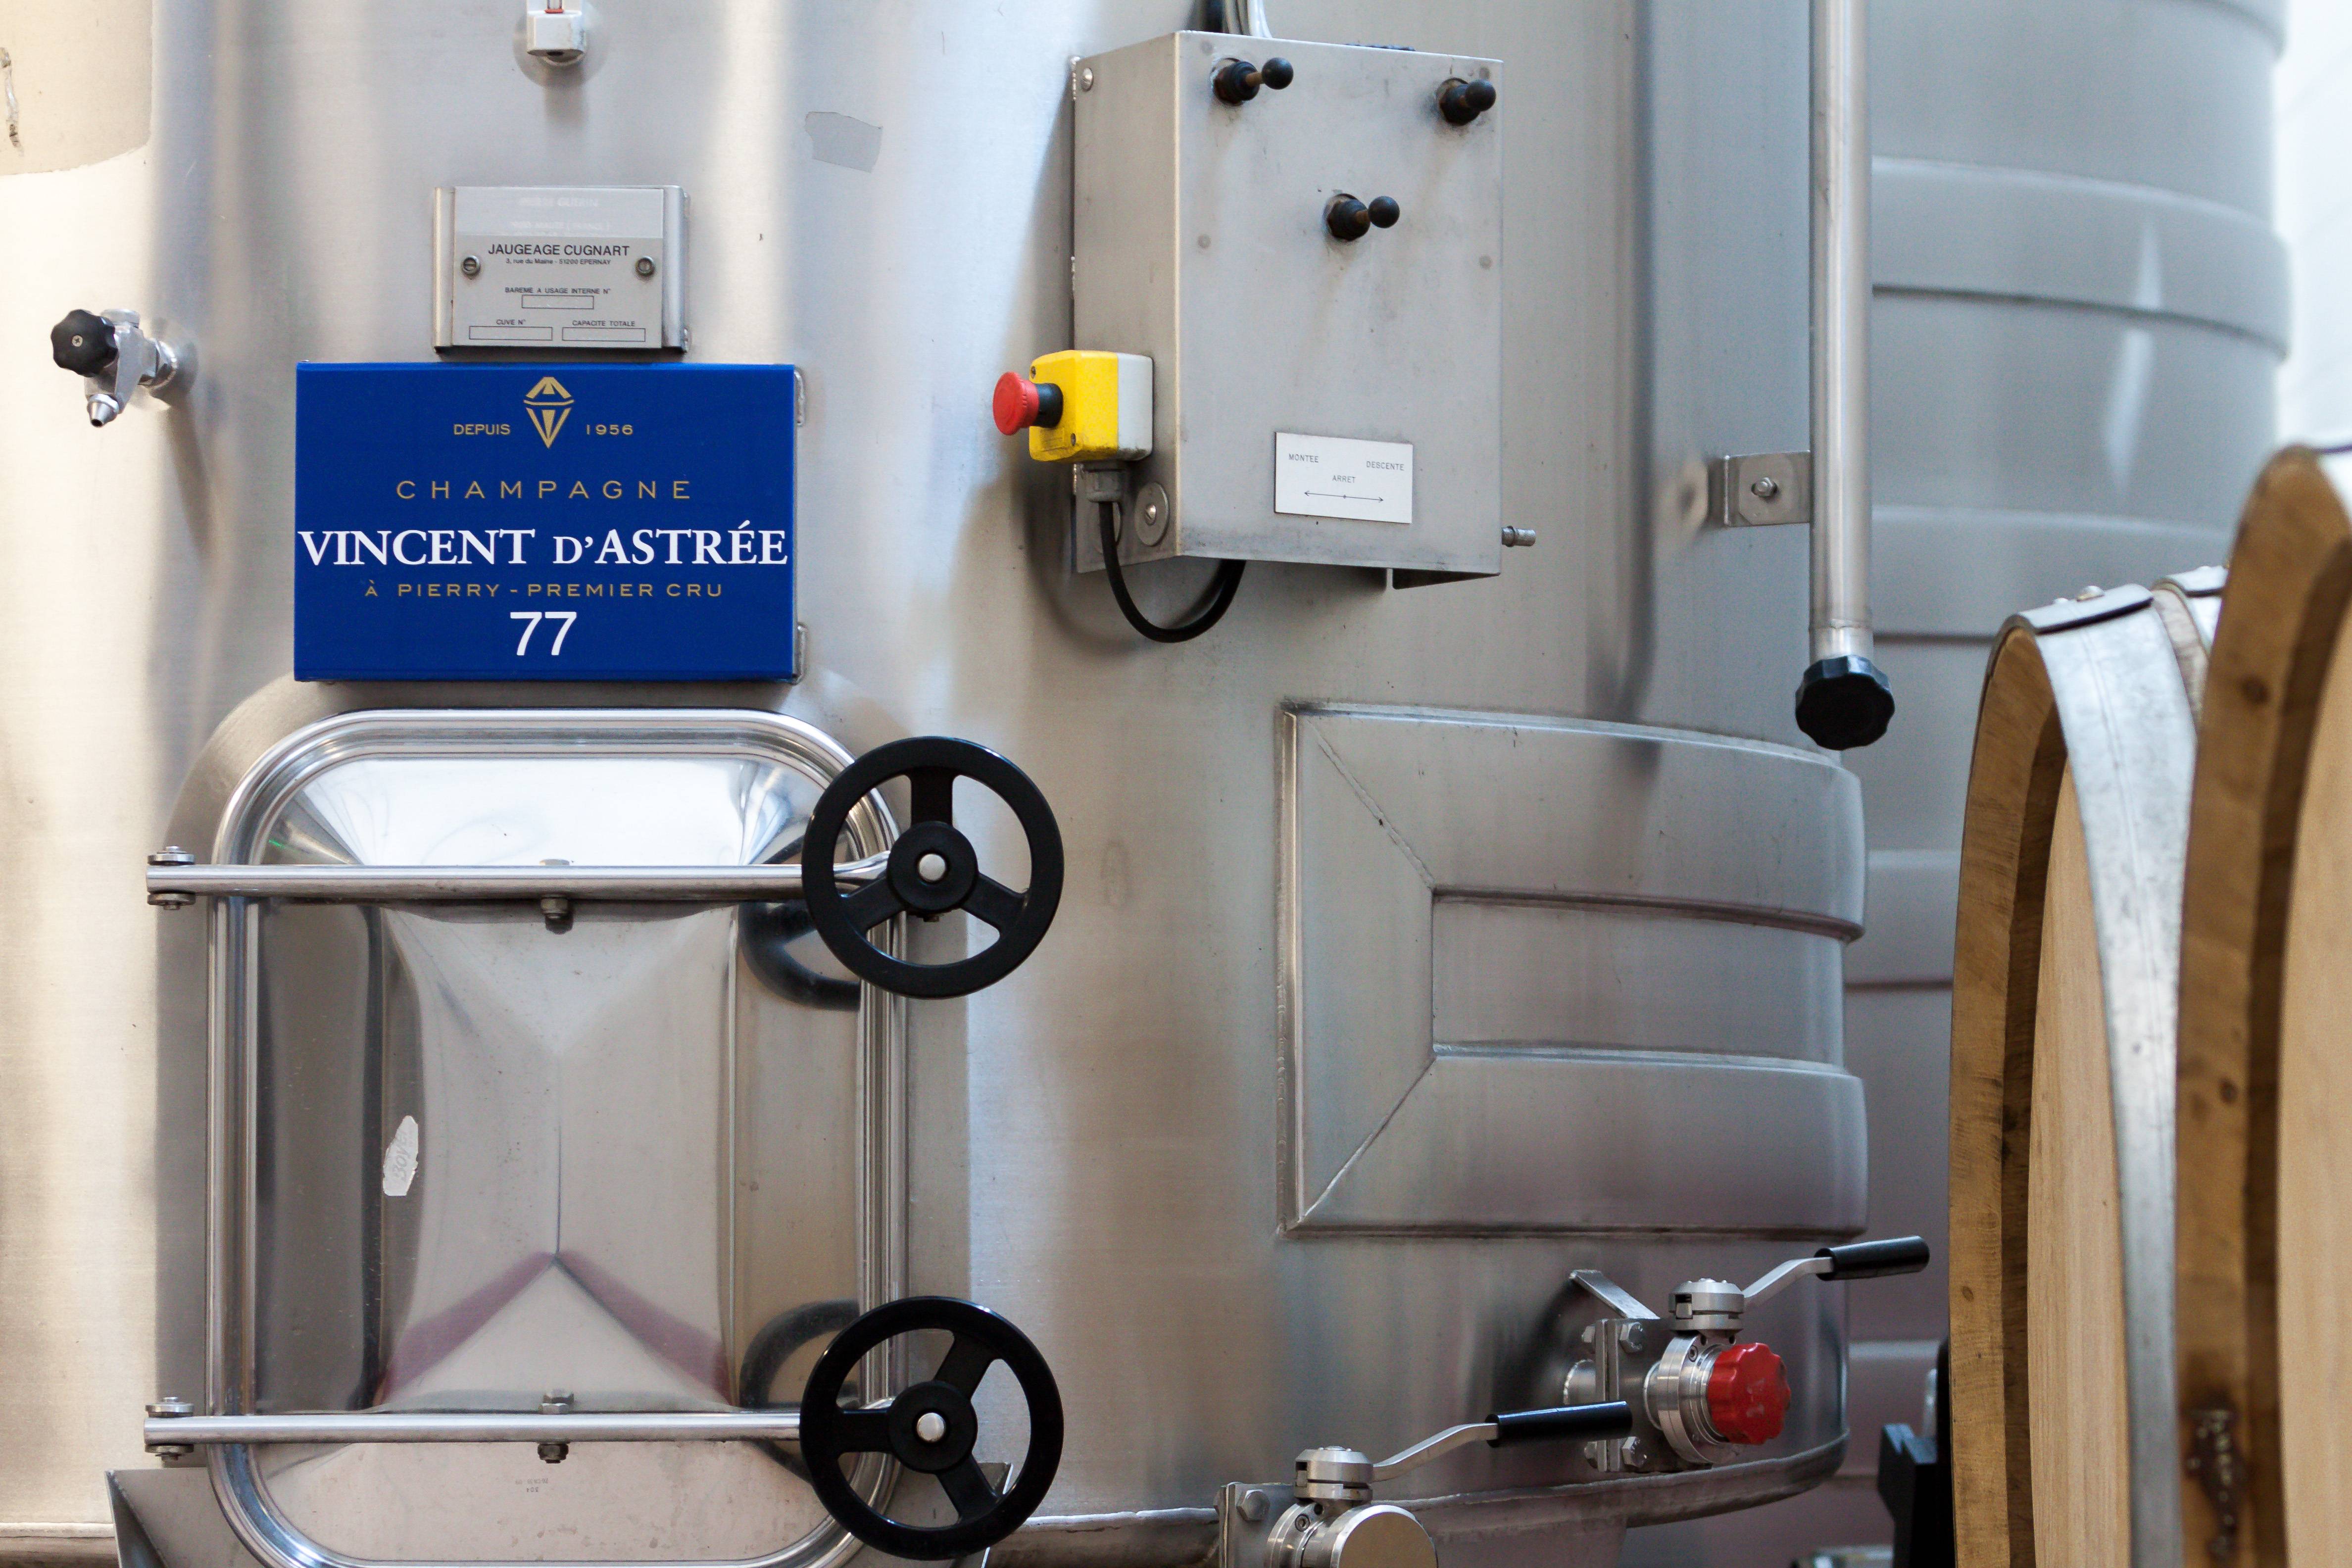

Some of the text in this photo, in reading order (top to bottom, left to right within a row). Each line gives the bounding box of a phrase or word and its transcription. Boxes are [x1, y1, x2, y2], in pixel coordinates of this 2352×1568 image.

[488, 244, 630, 256] JAUGEAGE CUGNART
[453, 423, 634, 436] DEPUIS 1956
[1289, 453, 1319, 463] MONTEE
[1366, 461, 1404, 471] DESCENTE
[1332, 475, 1356, 483] ARRET
[396, 480, 690, 499] CHAMPAGNE
[297, 520, 788, 566] VINCENT D'ASTRÉE
[365, 579, 378, 596] À
[398, 584, 499, 597] PIERRY
[527, 584, 653, 597] PREMIER
[666, 583, 722, 597] CRU
[510, 611, 577, 656] 77
